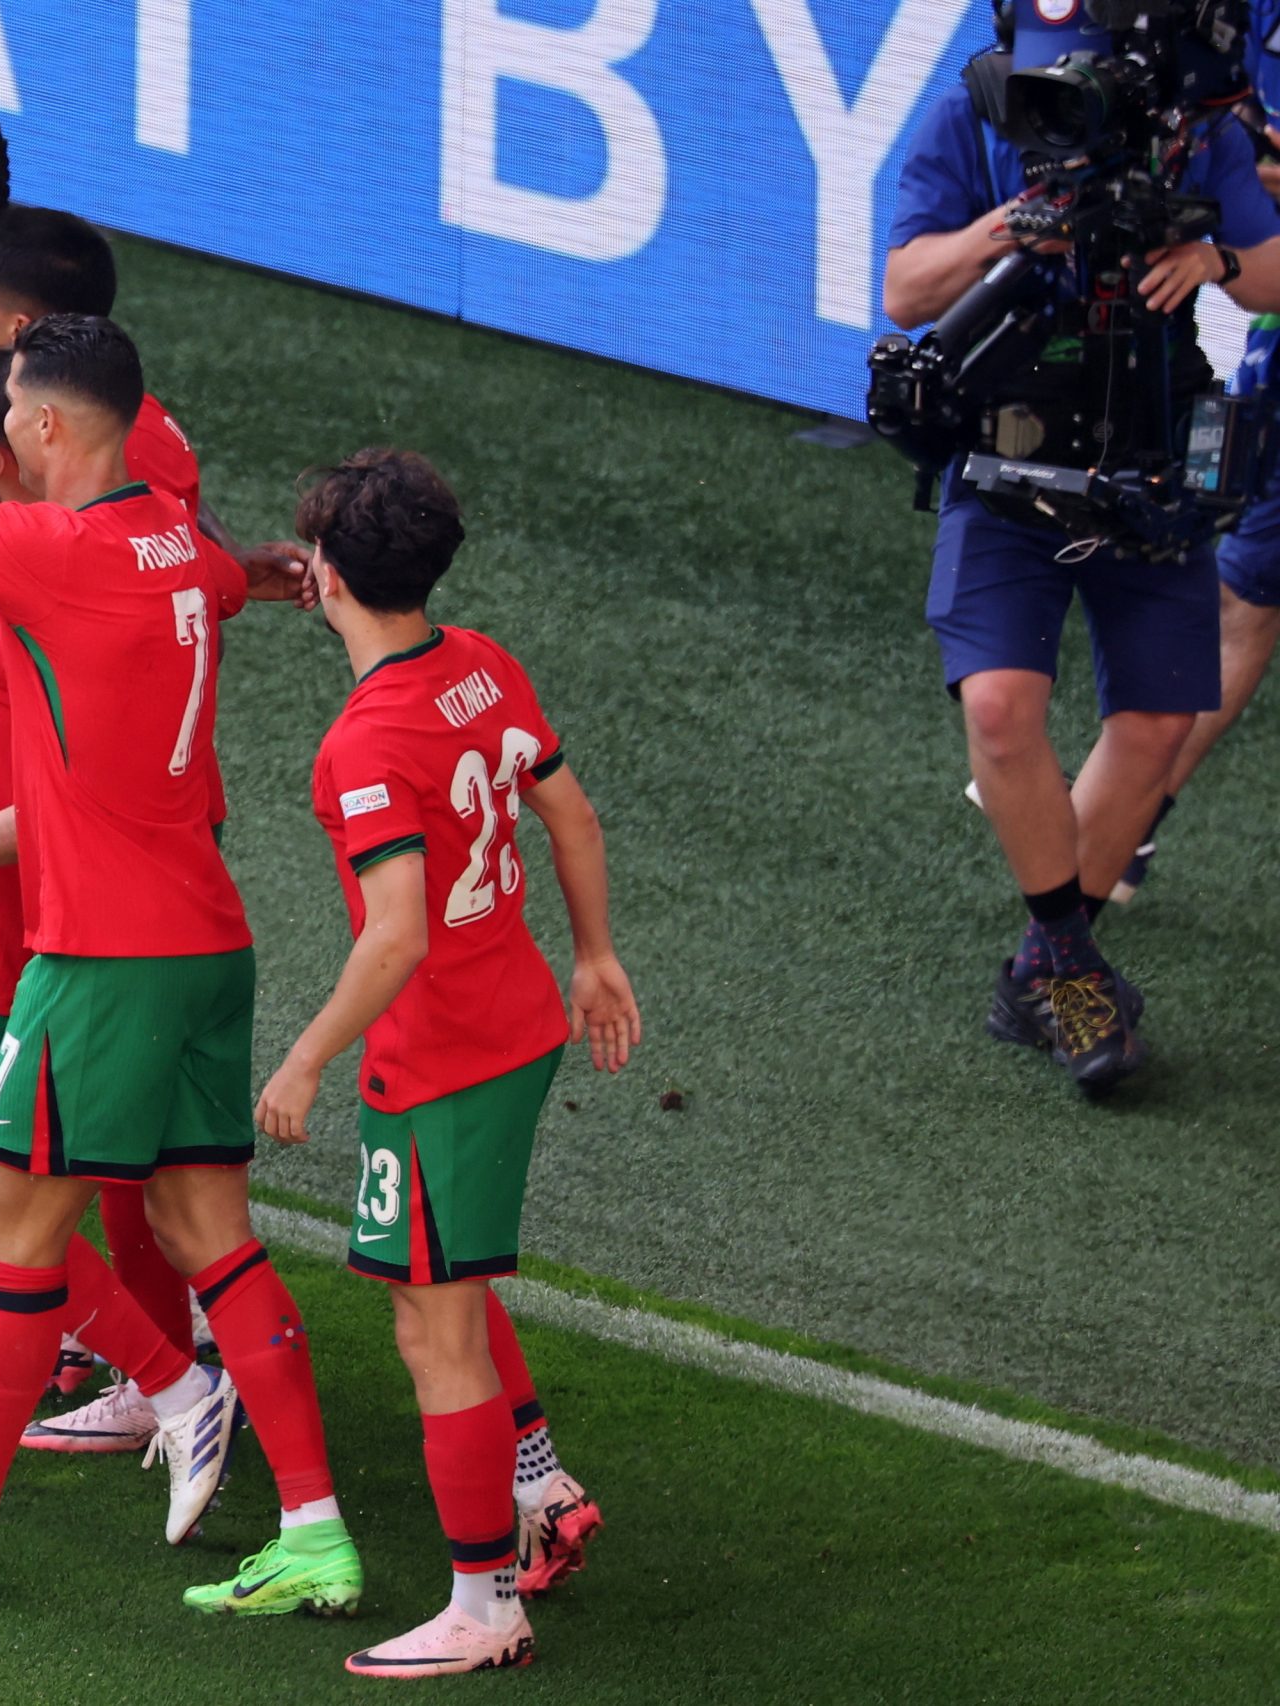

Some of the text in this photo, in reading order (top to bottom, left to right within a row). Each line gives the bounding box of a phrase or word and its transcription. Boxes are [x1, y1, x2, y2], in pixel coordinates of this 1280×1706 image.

[168, 587, 210, 776] 7
[434, 667, 503, 728] VITINHA
[443, 727, 542, 928] 23
[357, 1142, 401, 1227] 23
